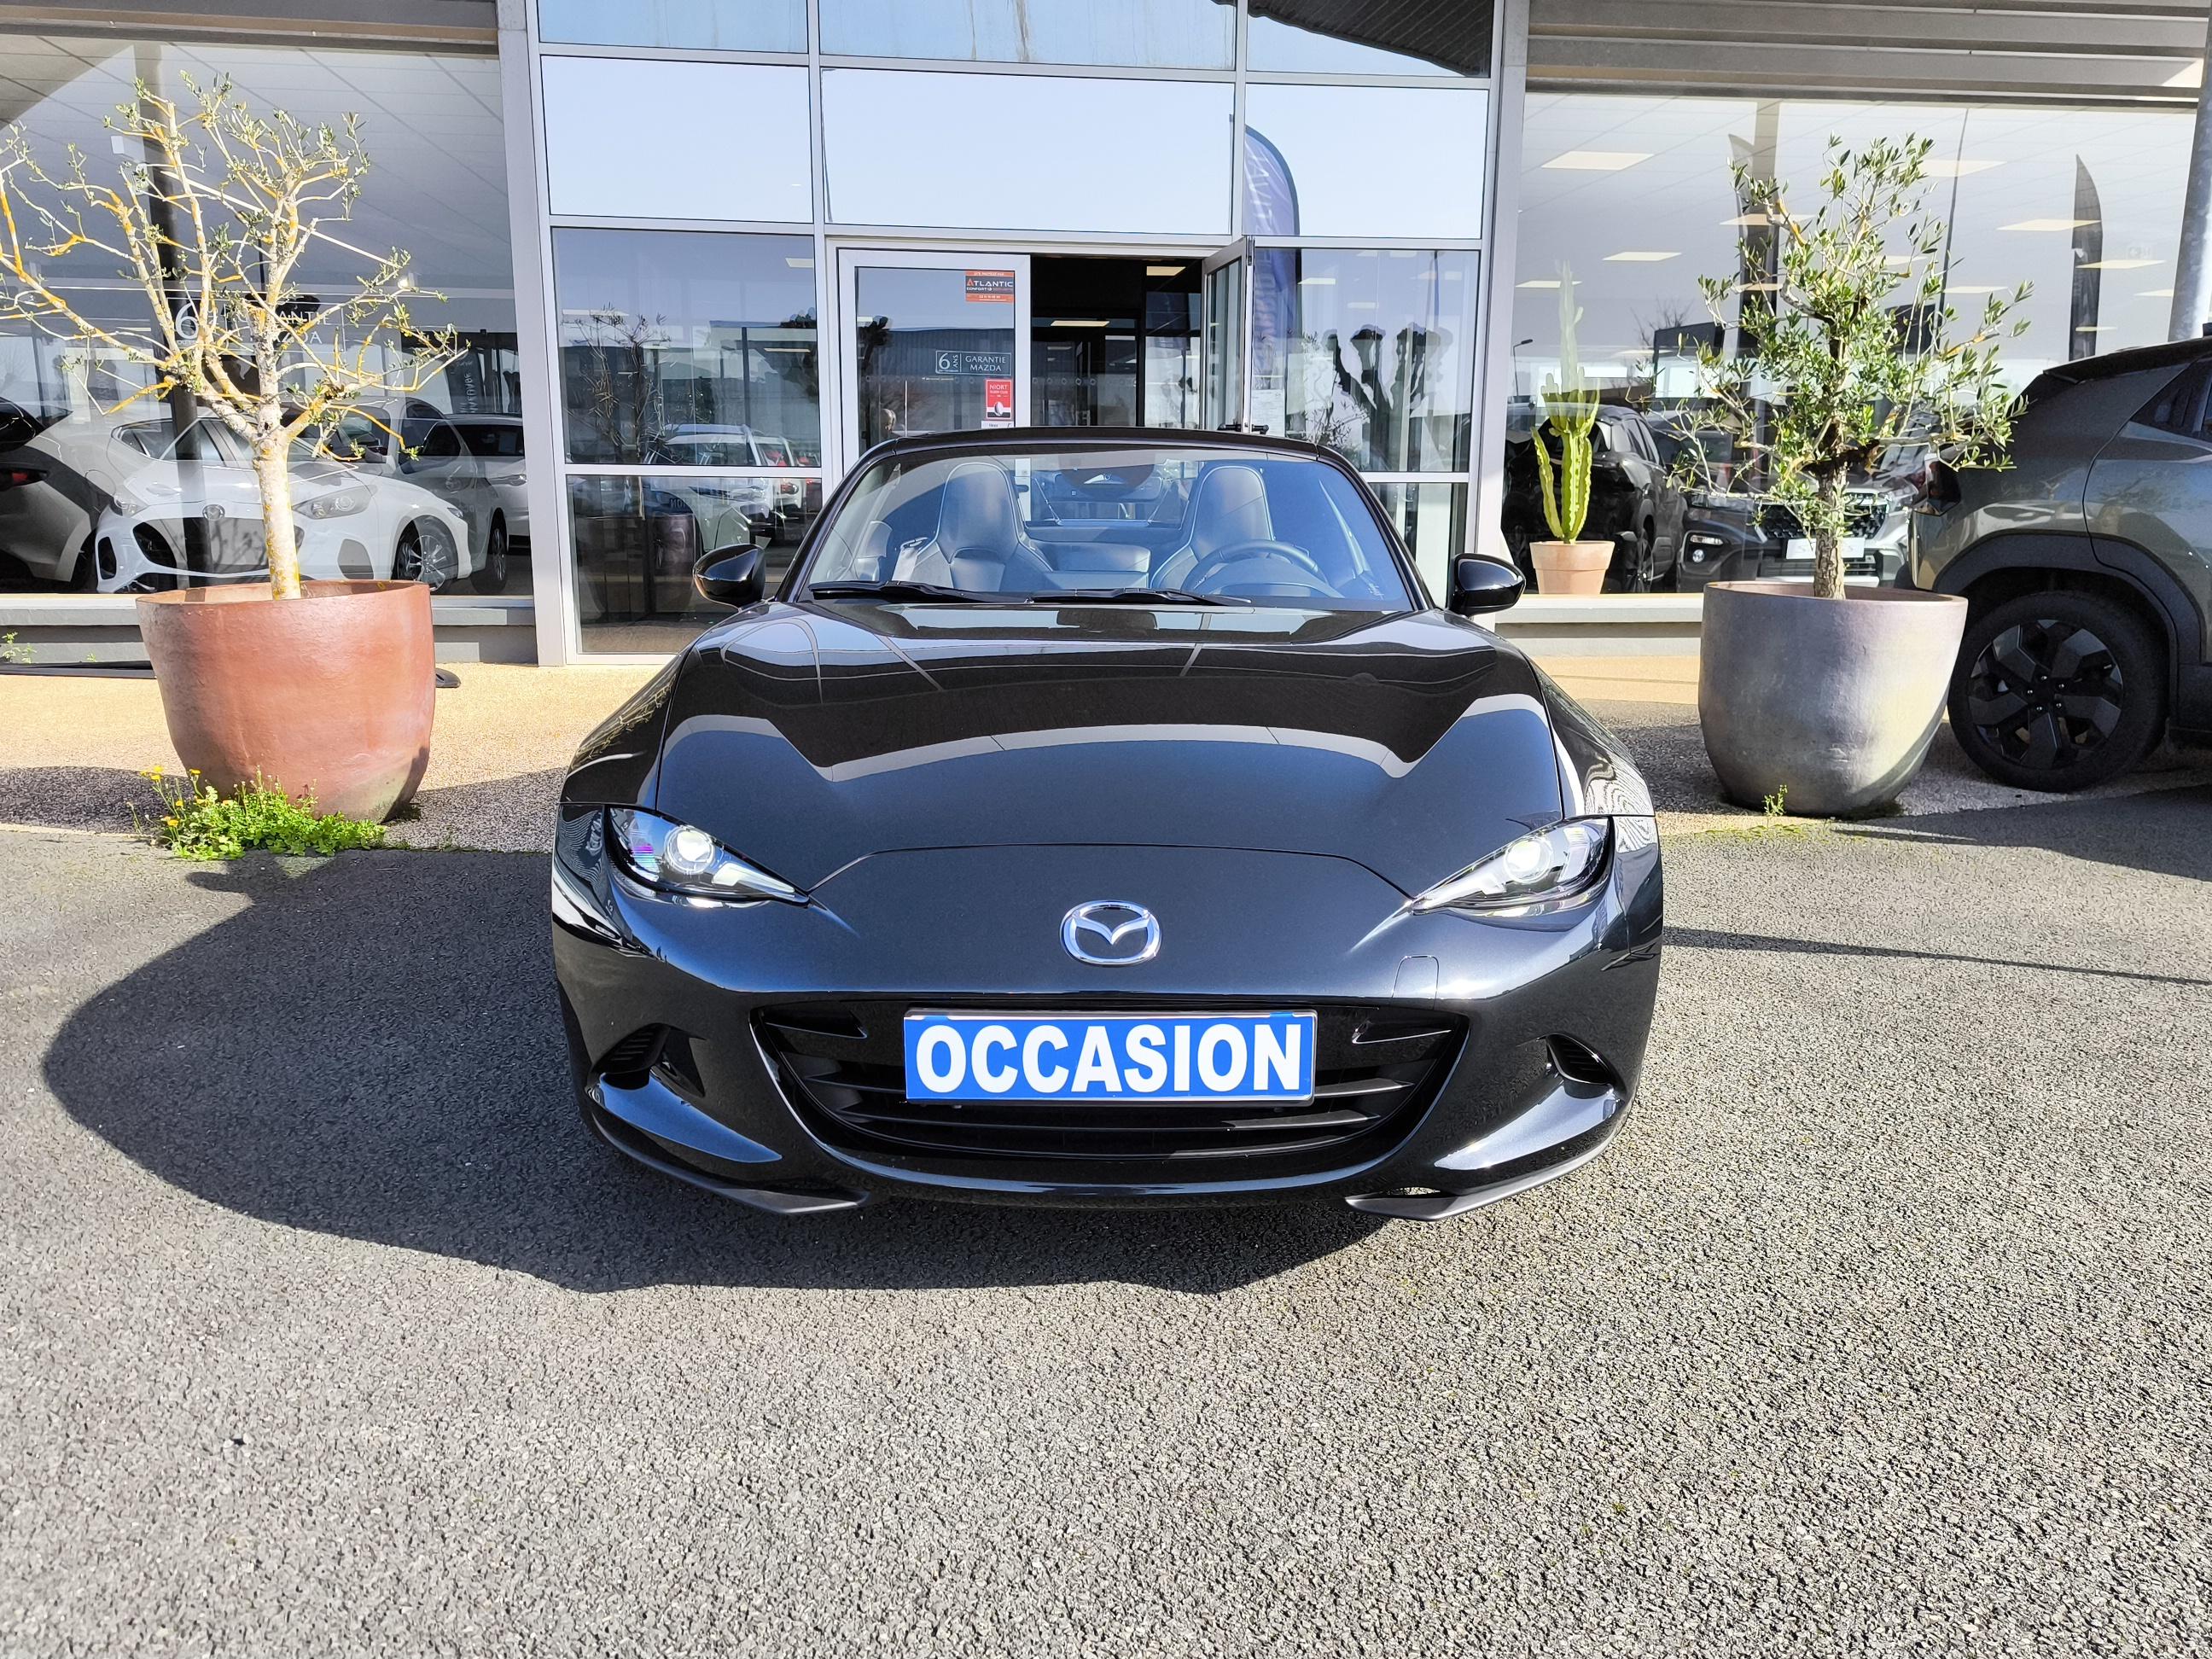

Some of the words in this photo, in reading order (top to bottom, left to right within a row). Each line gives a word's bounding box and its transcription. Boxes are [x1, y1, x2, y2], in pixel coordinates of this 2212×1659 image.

[967, 278, 1014, 288] ATLANTIC
[175, 302, 200, 339] 6
[939, 352, 951, 370] 6
[965, 355, 1006, 364] GARANTIE
[916, 1023, 1301, 1093] OCCASION
